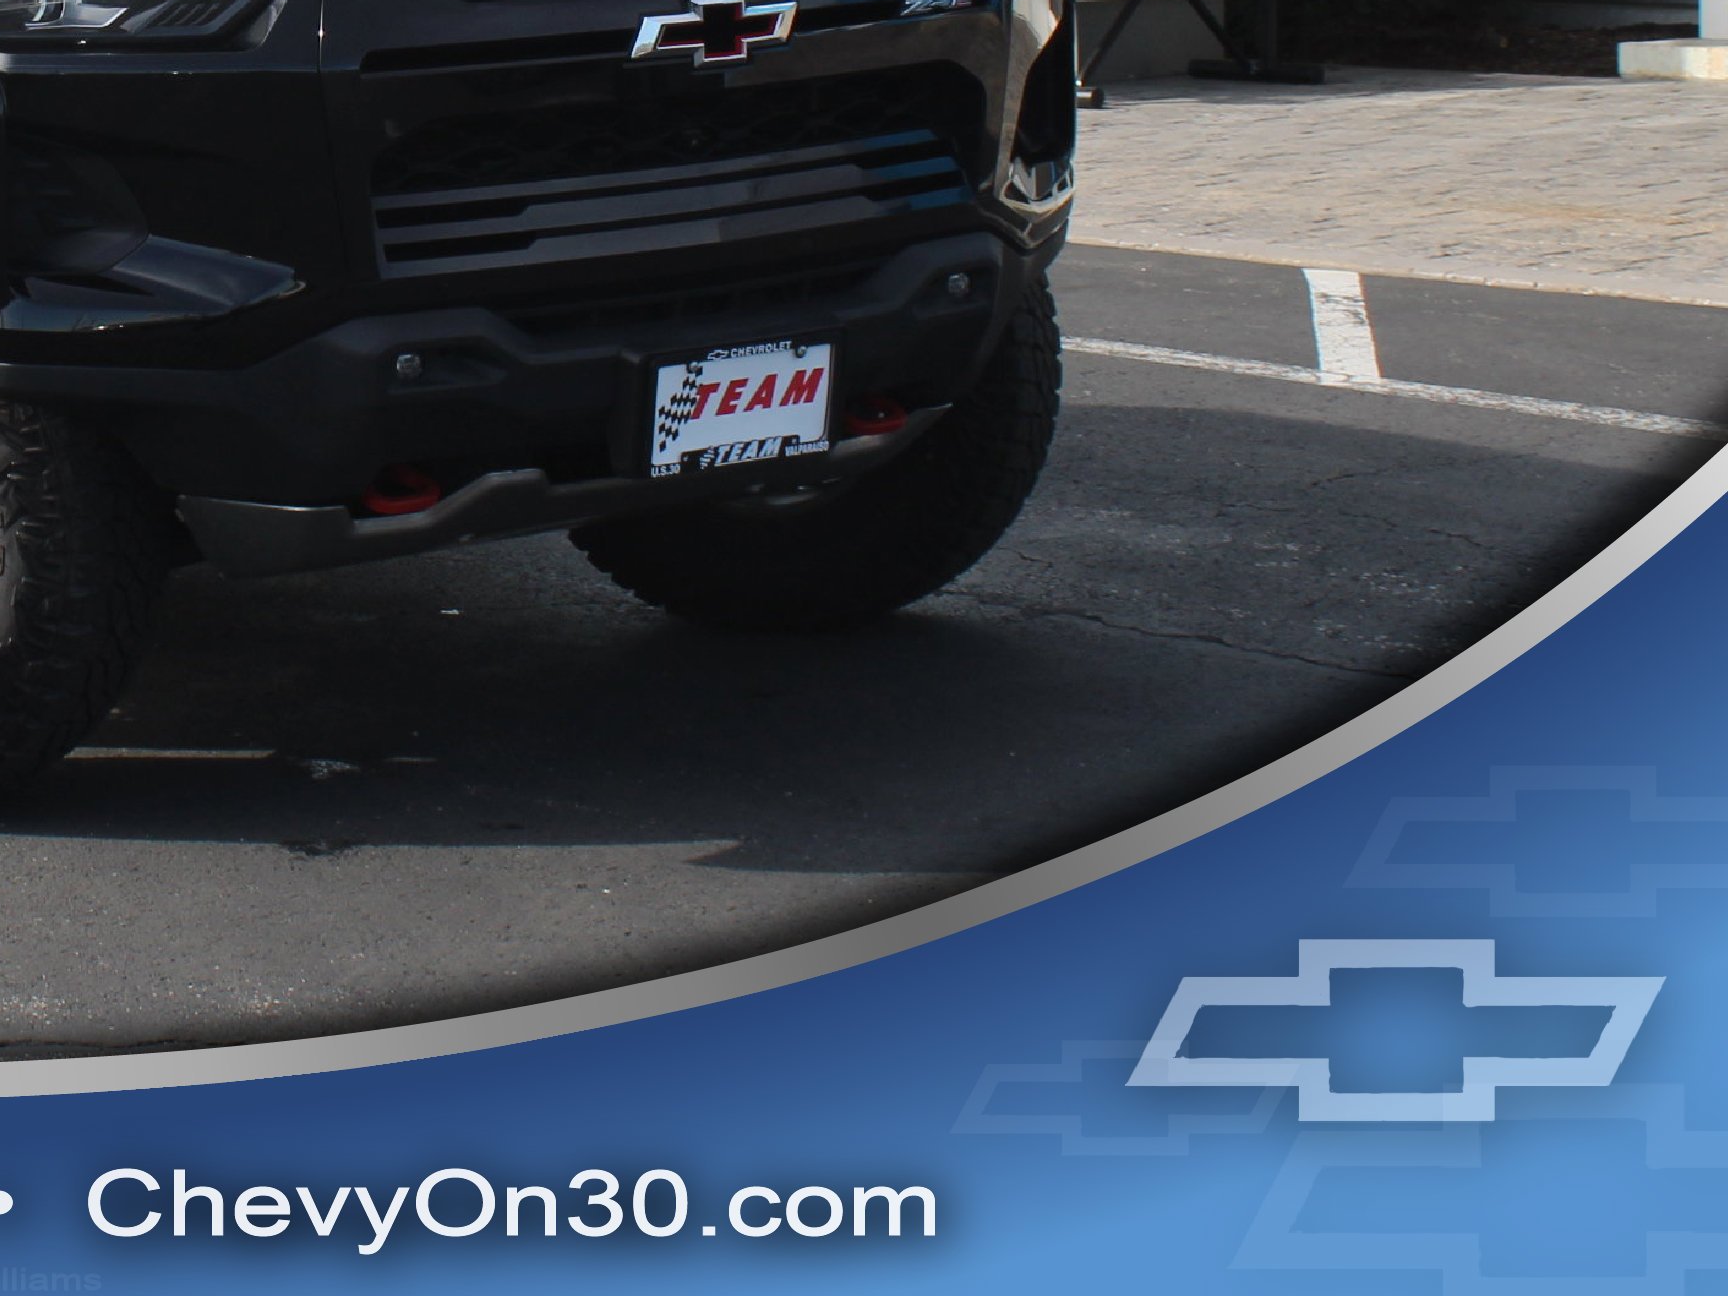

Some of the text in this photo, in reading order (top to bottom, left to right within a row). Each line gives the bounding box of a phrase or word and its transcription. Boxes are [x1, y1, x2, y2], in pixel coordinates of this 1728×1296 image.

[730, 341, 792, 358] CHEVROLET
[690, 367, 825, 420] TEAM
[714, 436, 783, 466] TEAM
